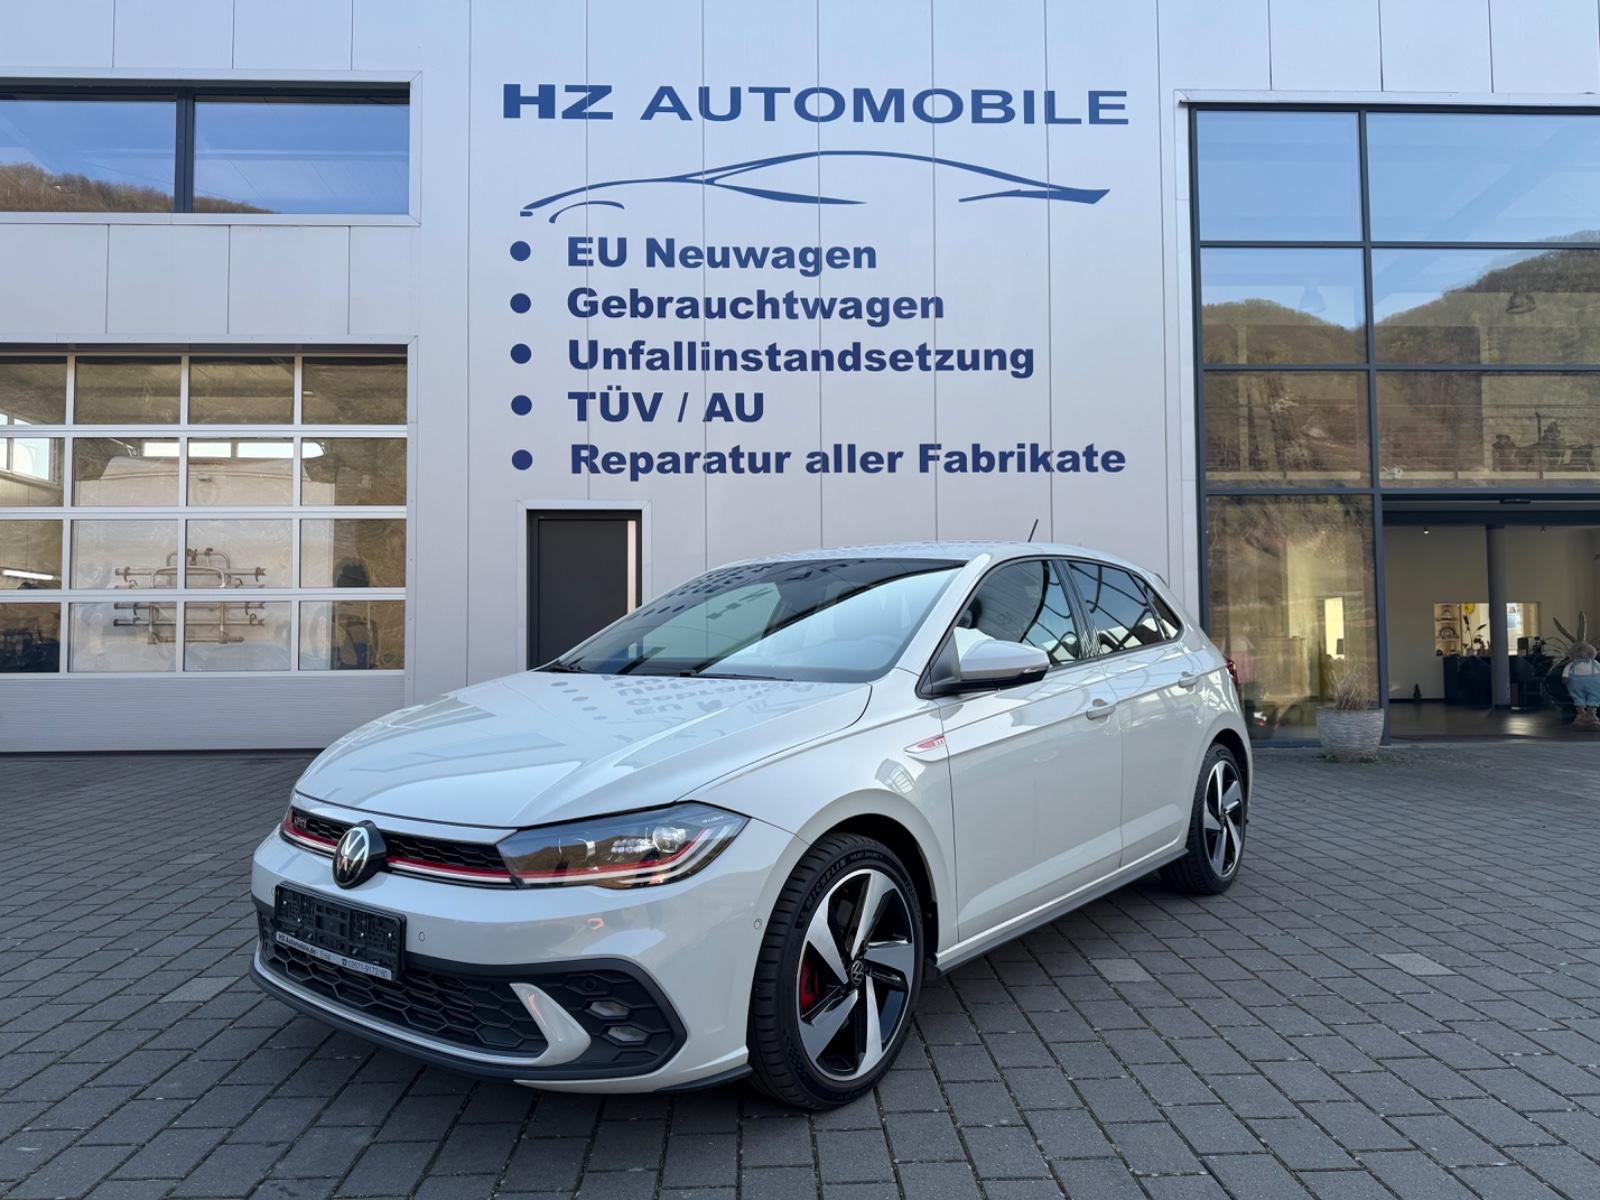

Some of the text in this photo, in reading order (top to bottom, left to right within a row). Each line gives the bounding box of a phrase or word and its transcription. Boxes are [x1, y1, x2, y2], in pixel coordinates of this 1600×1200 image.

[502, 83, 1129, 125] HZ AUTOMOBILE
[567, 236, 877, 278] EU Neuwagen
[567, 287, 944, 328] Gebrauchtwagen
[568, 339, 1034, 379] Unfallinstandsetzung
[567, 385, 664, 423] TÜV
[703, 392, 764, 423] AU
[571, 442, 1126, 482] Reparatur aller Fabrikate
